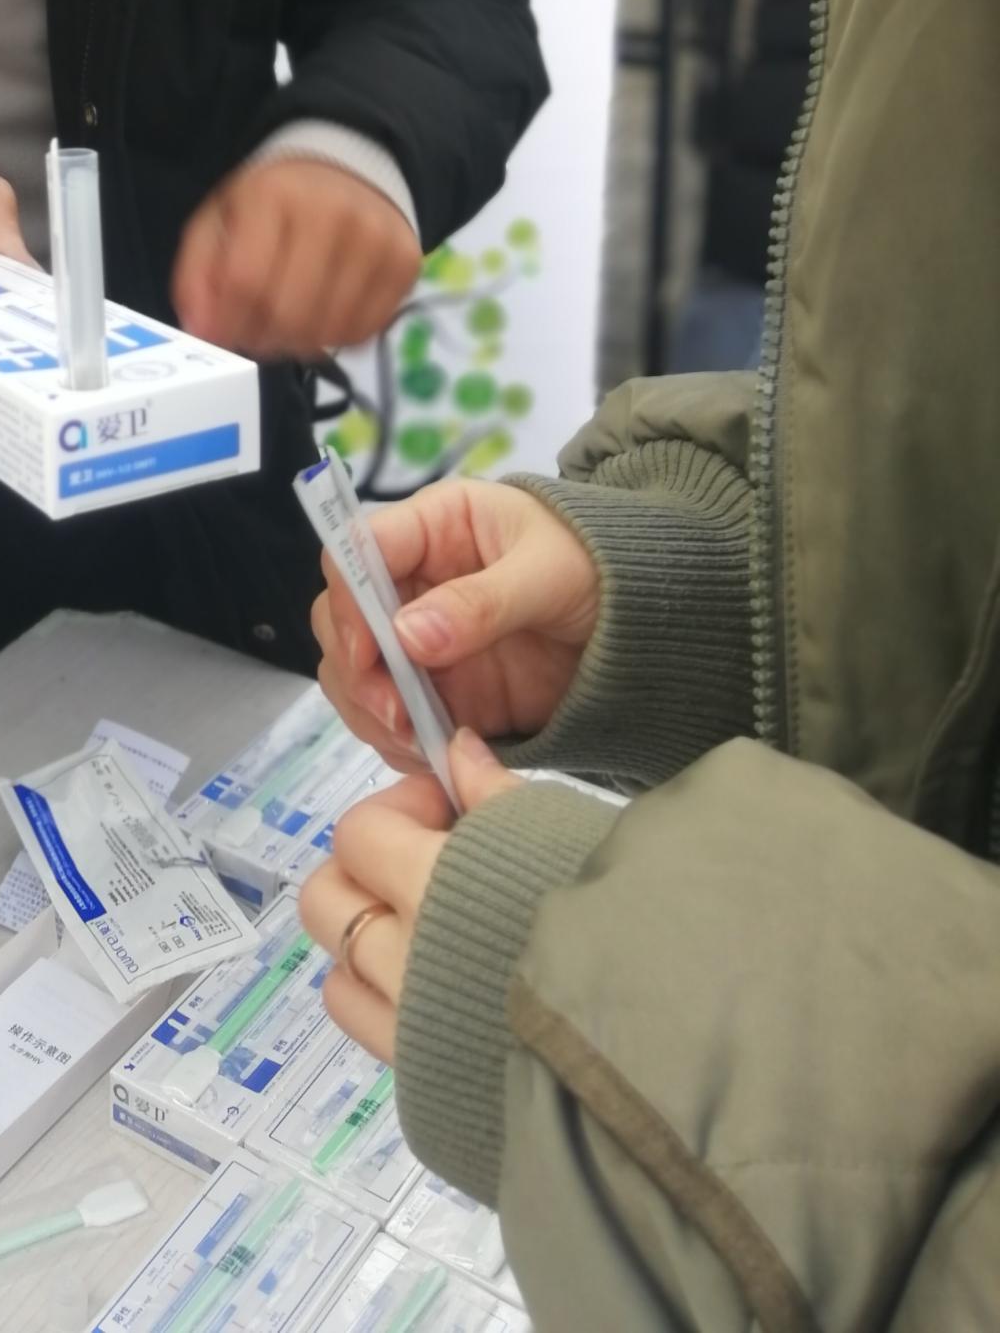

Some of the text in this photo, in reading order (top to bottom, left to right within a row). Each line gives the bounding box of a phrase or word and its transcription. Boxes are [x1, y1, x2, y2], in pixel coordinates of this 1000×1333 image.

[97, 408, 148, 444] 爱卫
[8, 1023, 72, 1065] 操作示意图
